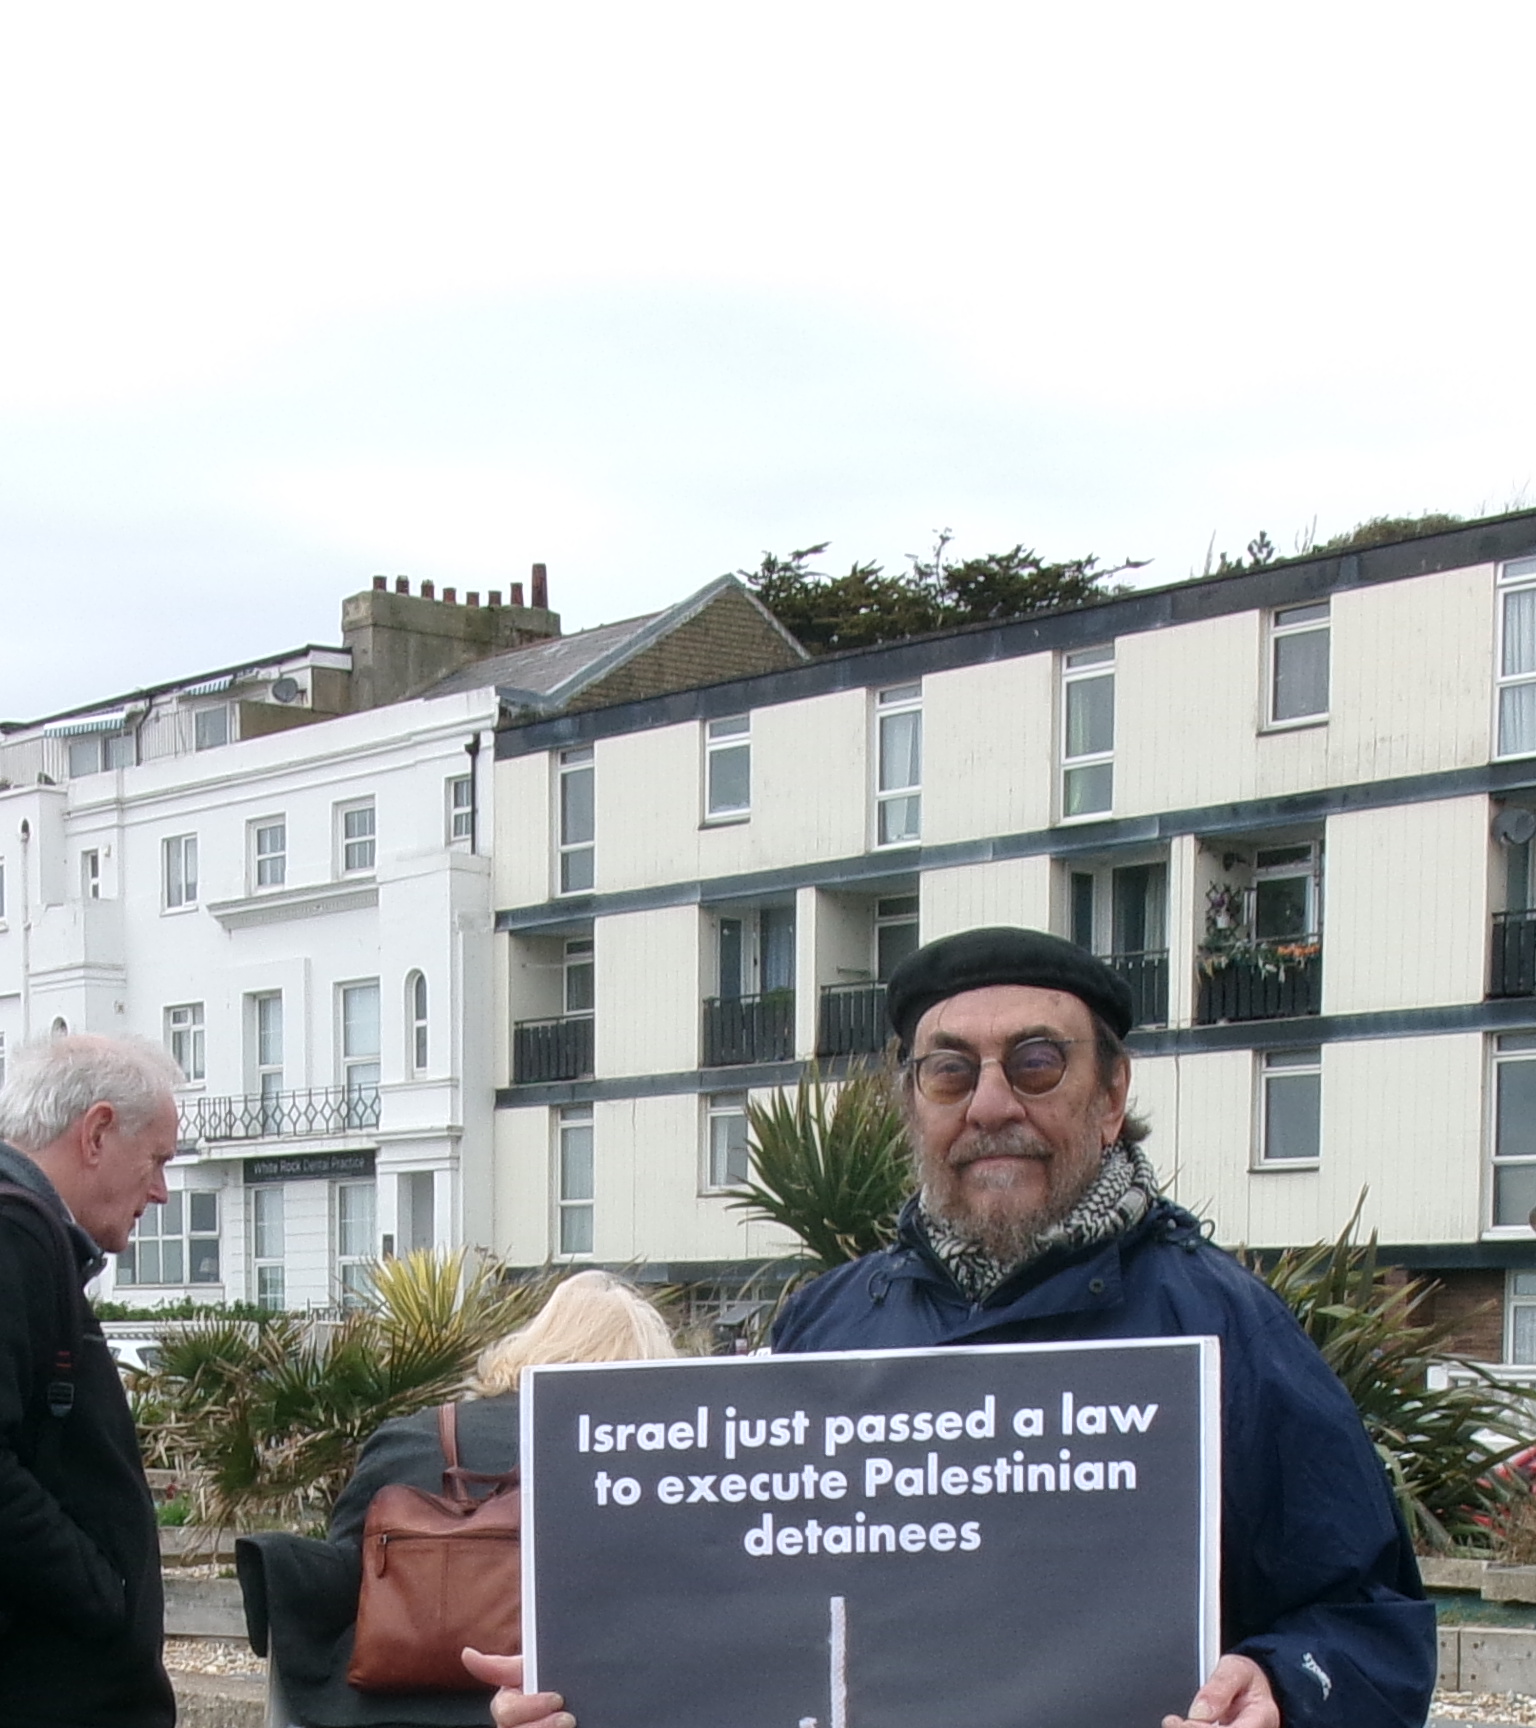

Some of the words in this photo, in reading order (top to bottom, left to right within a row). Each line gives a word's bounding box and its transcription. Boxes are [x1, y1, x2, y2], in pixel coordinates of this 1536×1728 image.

[280, 1159, 302, 1173] Rock
[579, 1406, 708, 1452] Israel
[725, 1407, 809, 1459] just
[825, 1395, 995, 1456] passed
[1013, 1409, 1043, 1437] a
[1062, 1392, 1158, 1435] law
[595, 1472, 641, 1505] to
[658, 1465, 847, 1504] execute
[865, 1449, 1136, 1497] Palestinian
[744, 1512, 981, 1556] detainees
